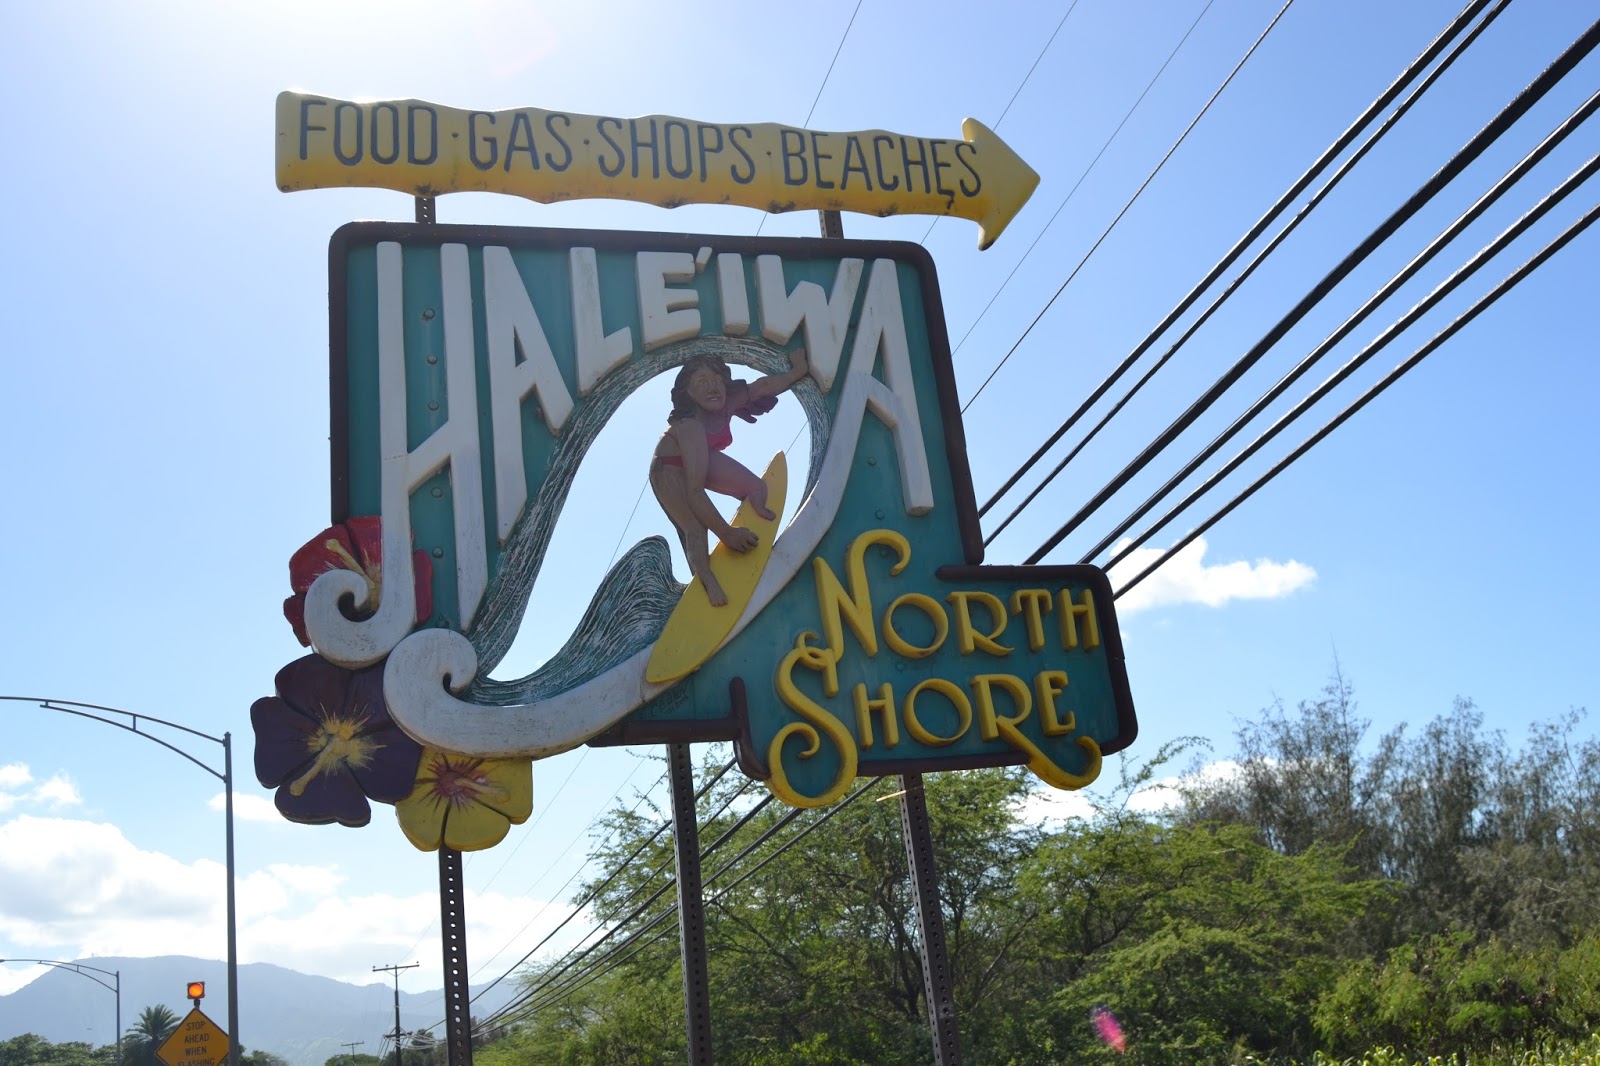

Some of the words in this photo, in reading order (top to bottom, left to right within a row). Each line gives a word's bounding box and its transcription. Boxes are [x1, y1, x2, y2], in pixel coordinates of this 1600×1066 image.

[299, 99, 438, 167] FOOD
[468, 110, 573, 173] GAS
[597, 117, 756, 185] SHOPS
[780, 128, 982, 198] BEACHES
[812, 528, 1100, 663] NORTH
[764, 631, 1102, 809] SHORE
[184, 1033, 210, 1044] AHEAD
[185, 1046, 207, 1057] WHEN
[186, 1021, 206, 1031] STOP
